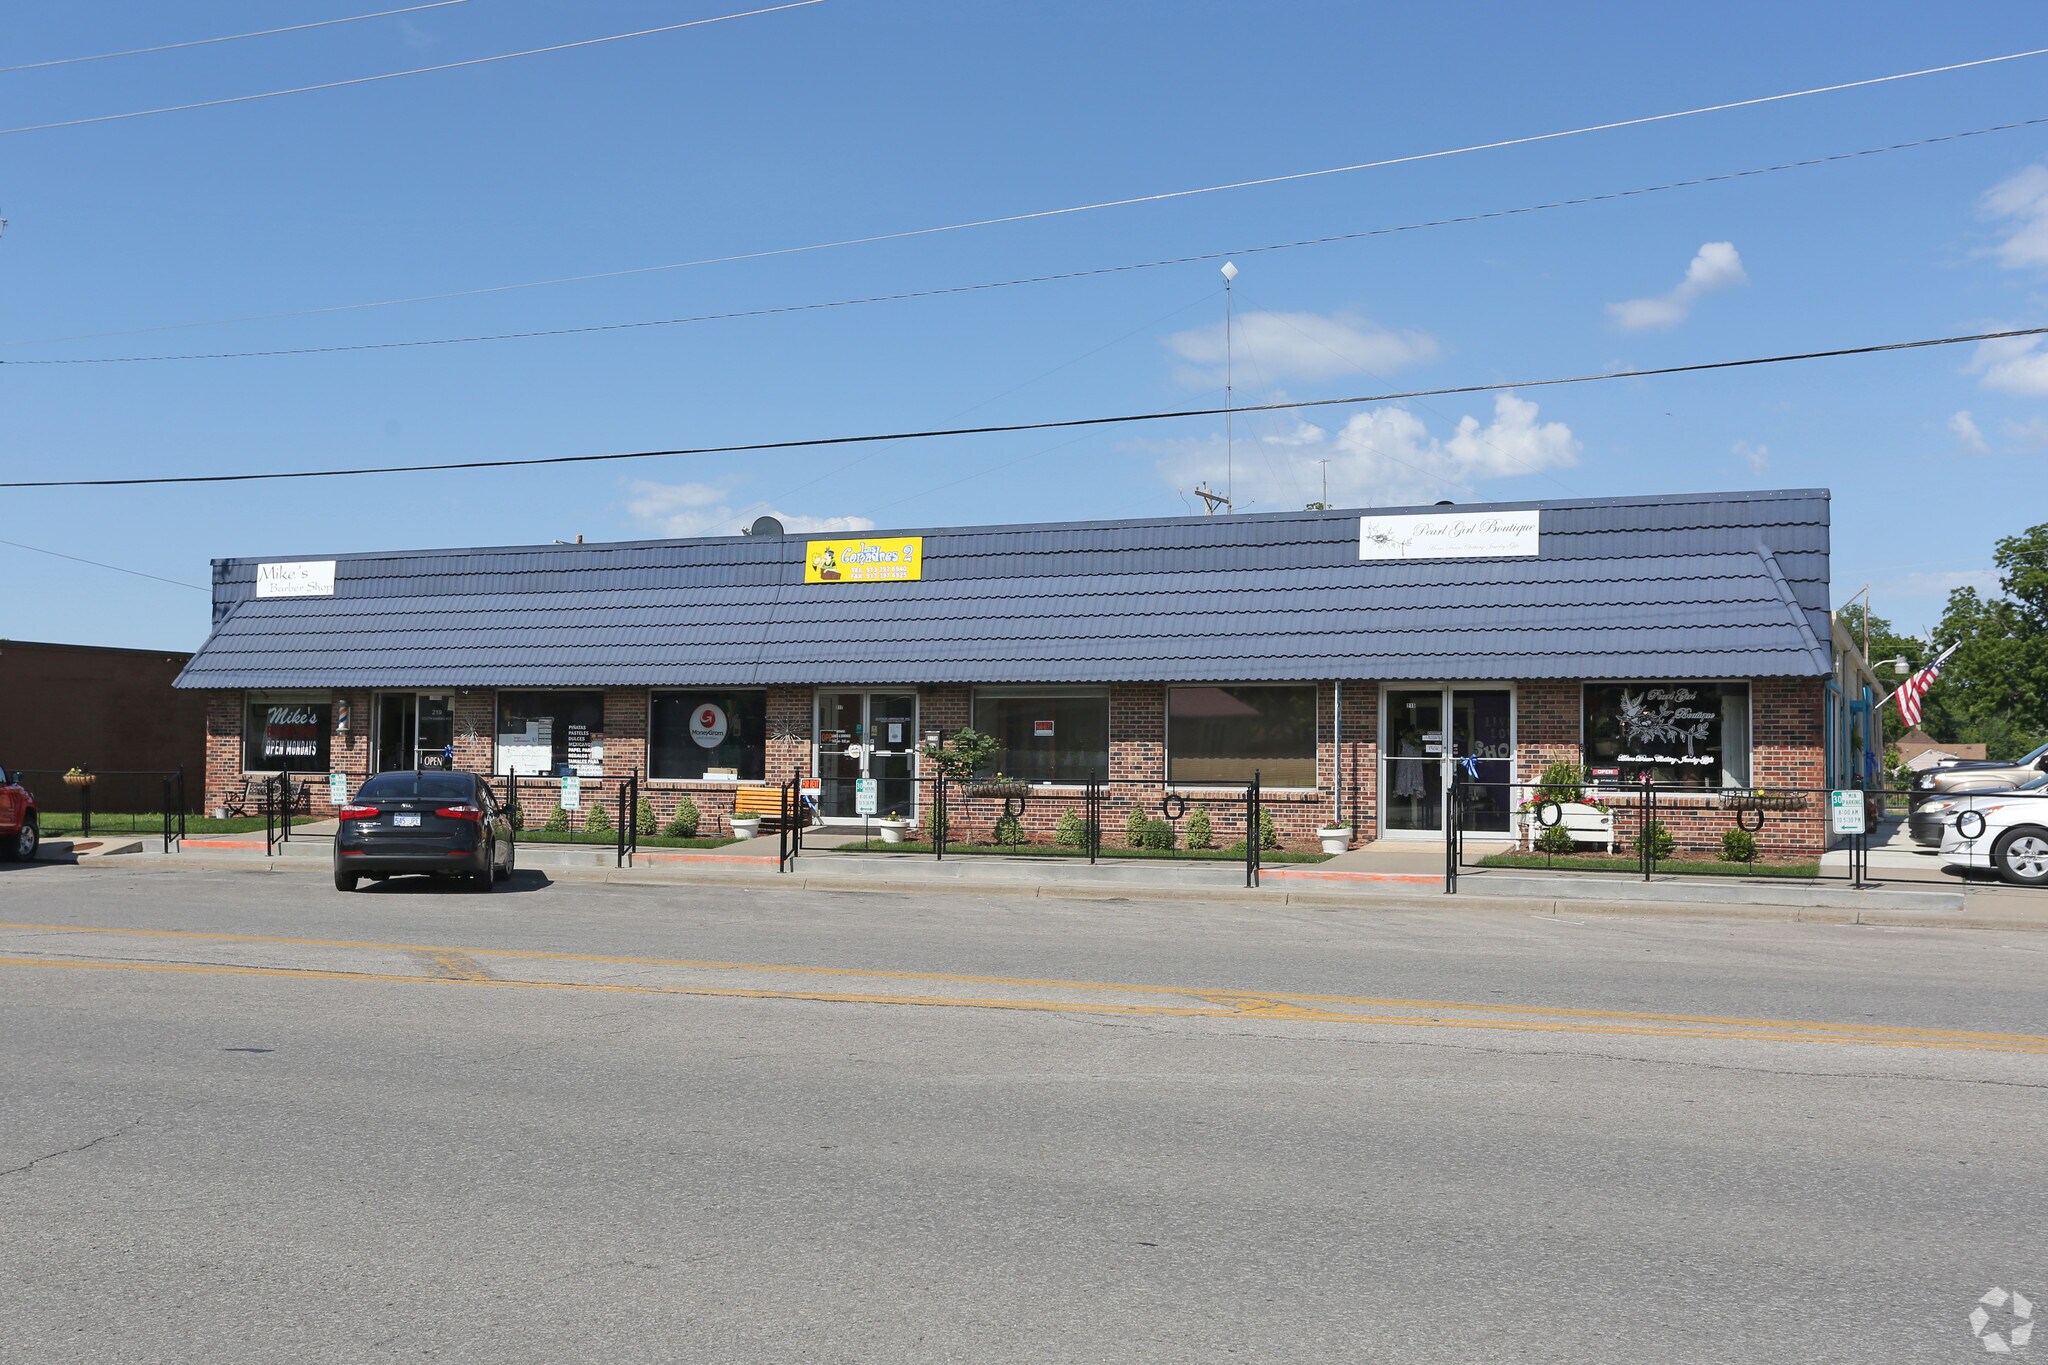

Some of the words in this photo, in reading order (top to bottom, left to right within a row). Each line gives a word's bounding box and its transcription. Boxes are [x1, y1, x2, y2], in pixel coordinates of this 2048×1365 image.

[1413, 522, 1448, 537] Pearl
[1448, 520, 1478, 538] Girl
[1479, 518, 1536, 537] Boutique
[861, 542, 877, 553] Las
[903, 545, 913, 563] 2
[259, 565, 308, 582] Mike's
[270, 582, 304, 593] Barber
[307, 581, 333, 593] Shop
[268, 706, 317, 724] Mike's
[1485, 717, 1509, 727] LIV
[266, 740, 284, 755] OPEN
[286, 740, 317, 756] MONDAYS
[1475, 740, 1510, 757] SHO
[424, 756, 442, 766] OPEN
[1833, 795, 1842, 804] 30
